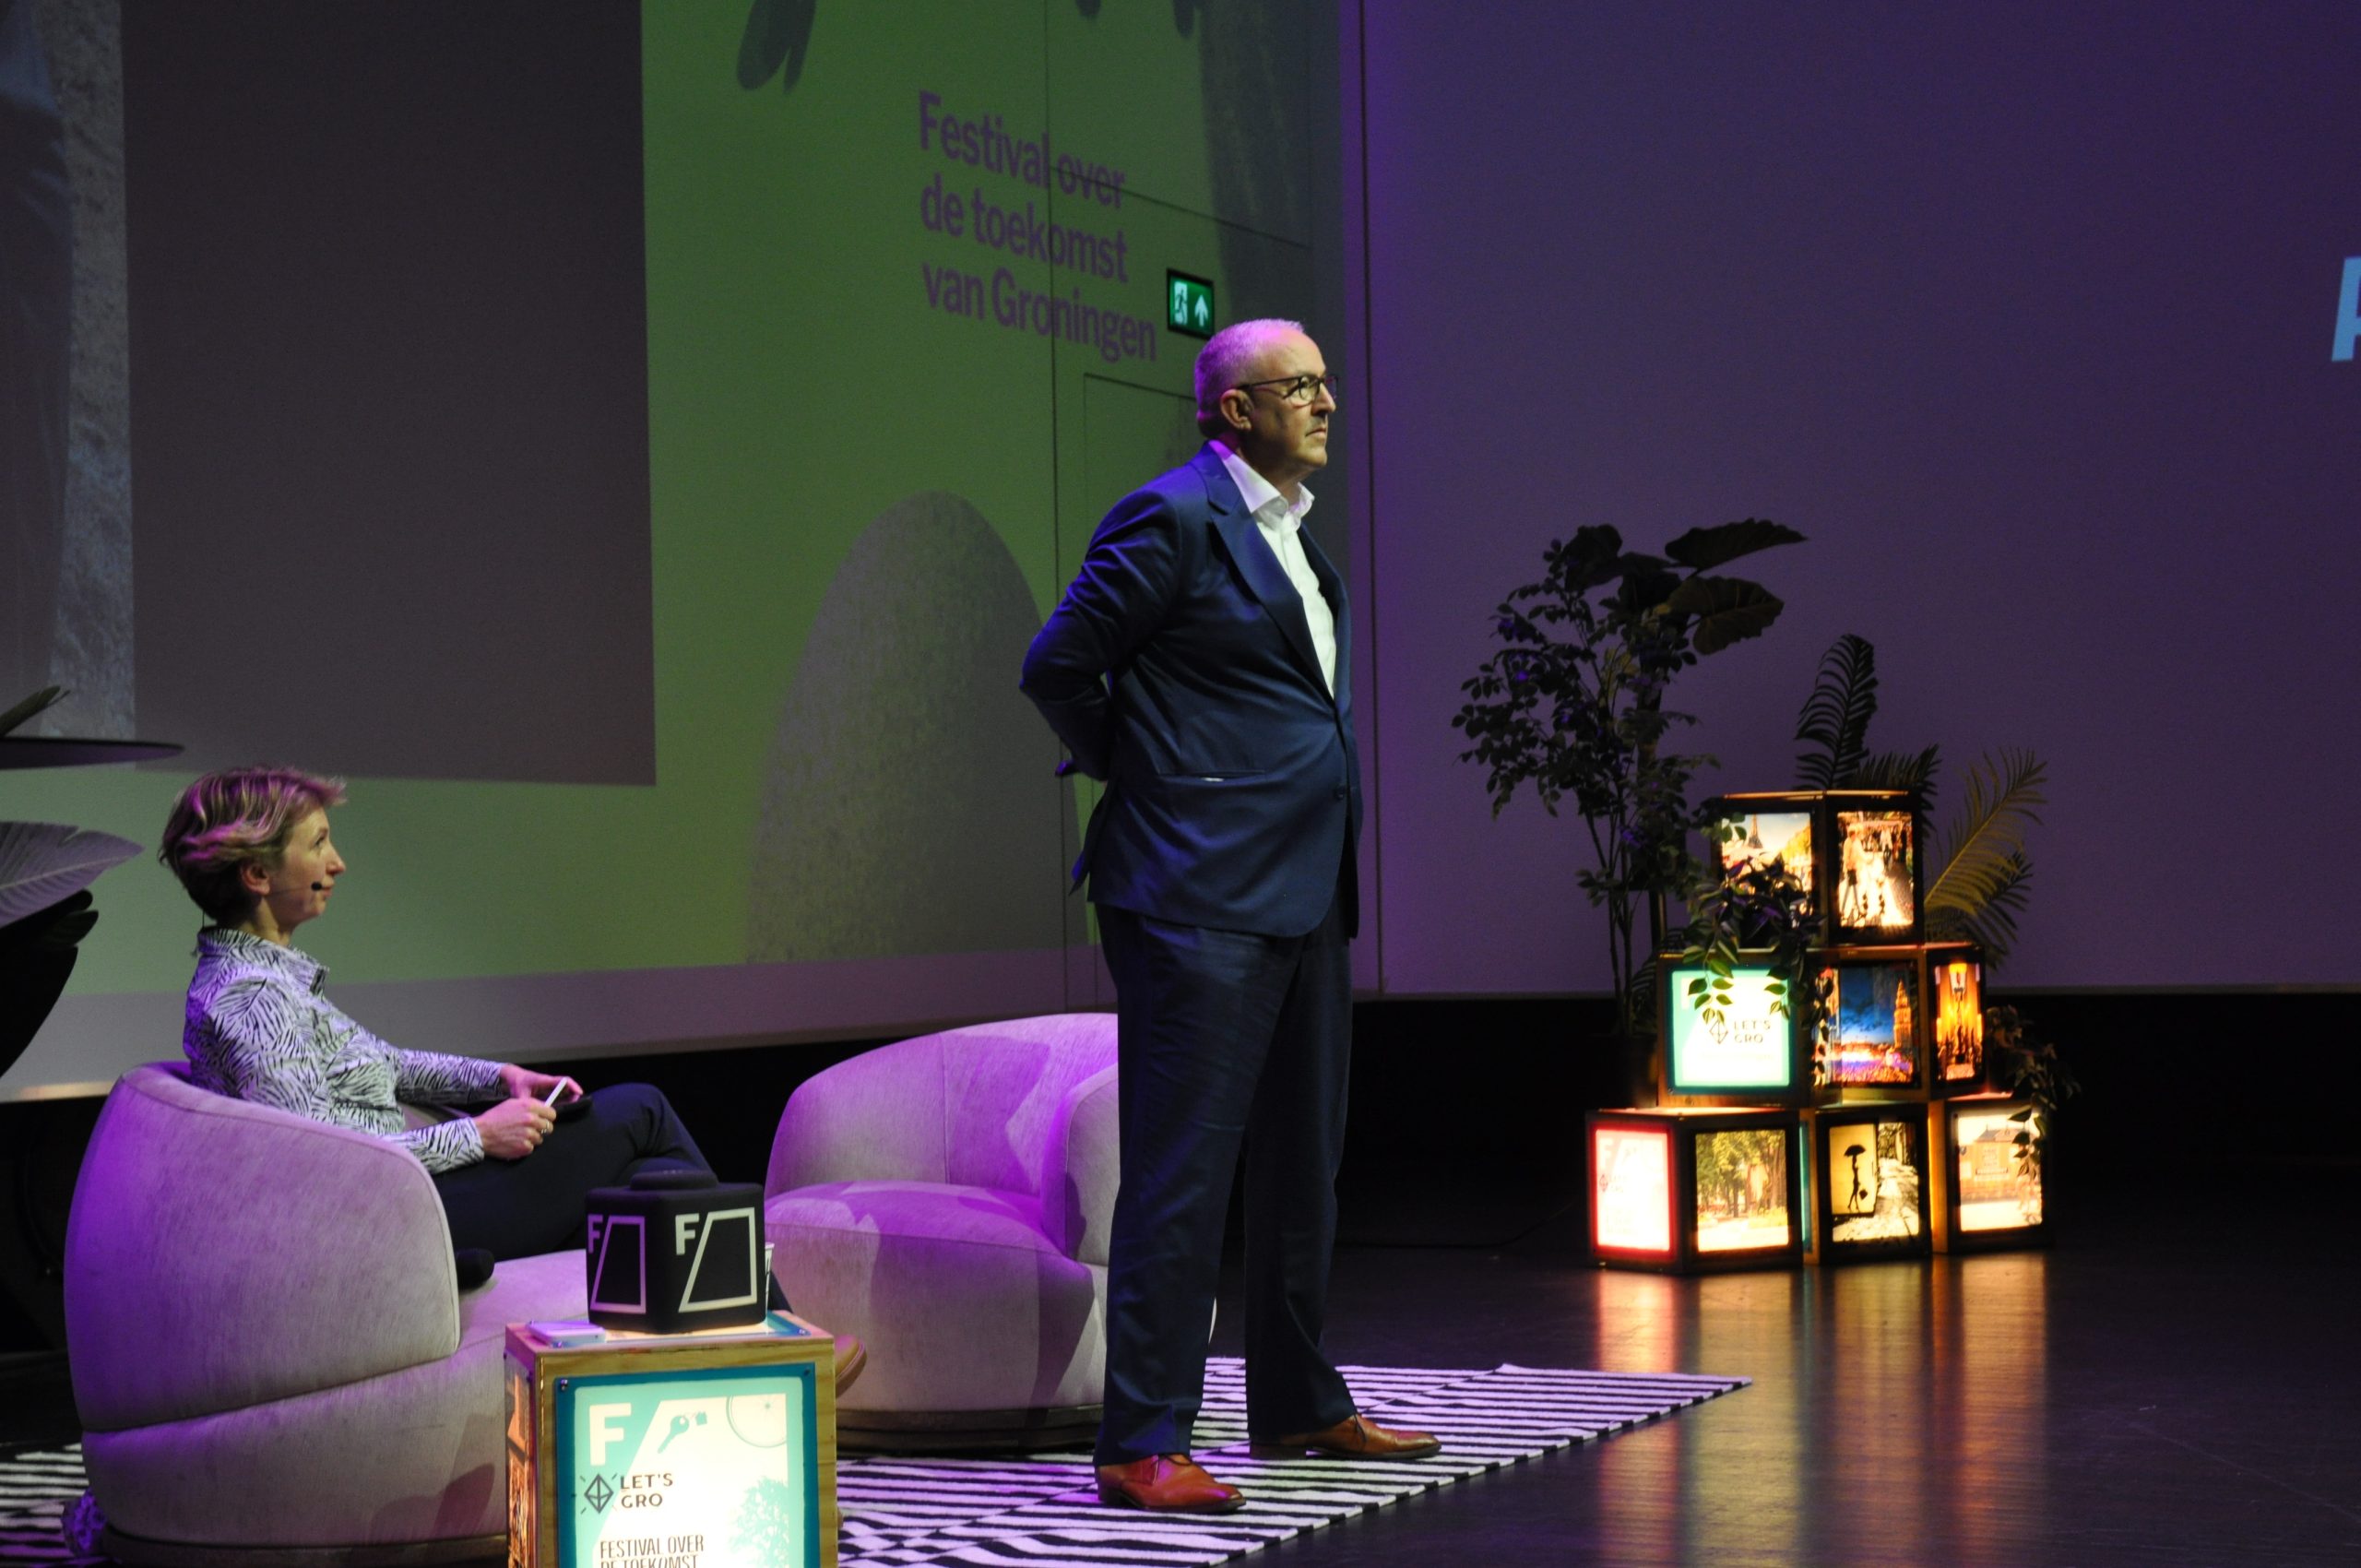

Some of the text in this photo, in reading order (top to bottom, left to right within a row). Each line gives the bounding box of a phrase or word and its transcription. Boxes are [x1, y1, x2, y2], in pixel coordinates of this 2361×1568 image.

[919, 89, 1125, 208] Festival over
[922, 172, 1129, 284] de toekomst
[922, 261, 1157, 363] van Groningen
[1734, 1019, 1772, 1031] LET'S
[587, 1214, 604, 1253] F
[675, 1213, 700, 1255] F
[589, 1403, 632, 1467] F
[620, 1473, 673, 1491] LET'S
[621, 1492, 663, 1509] GRO
[599, 1534, 705, 1560] FESTIVAL OVER
